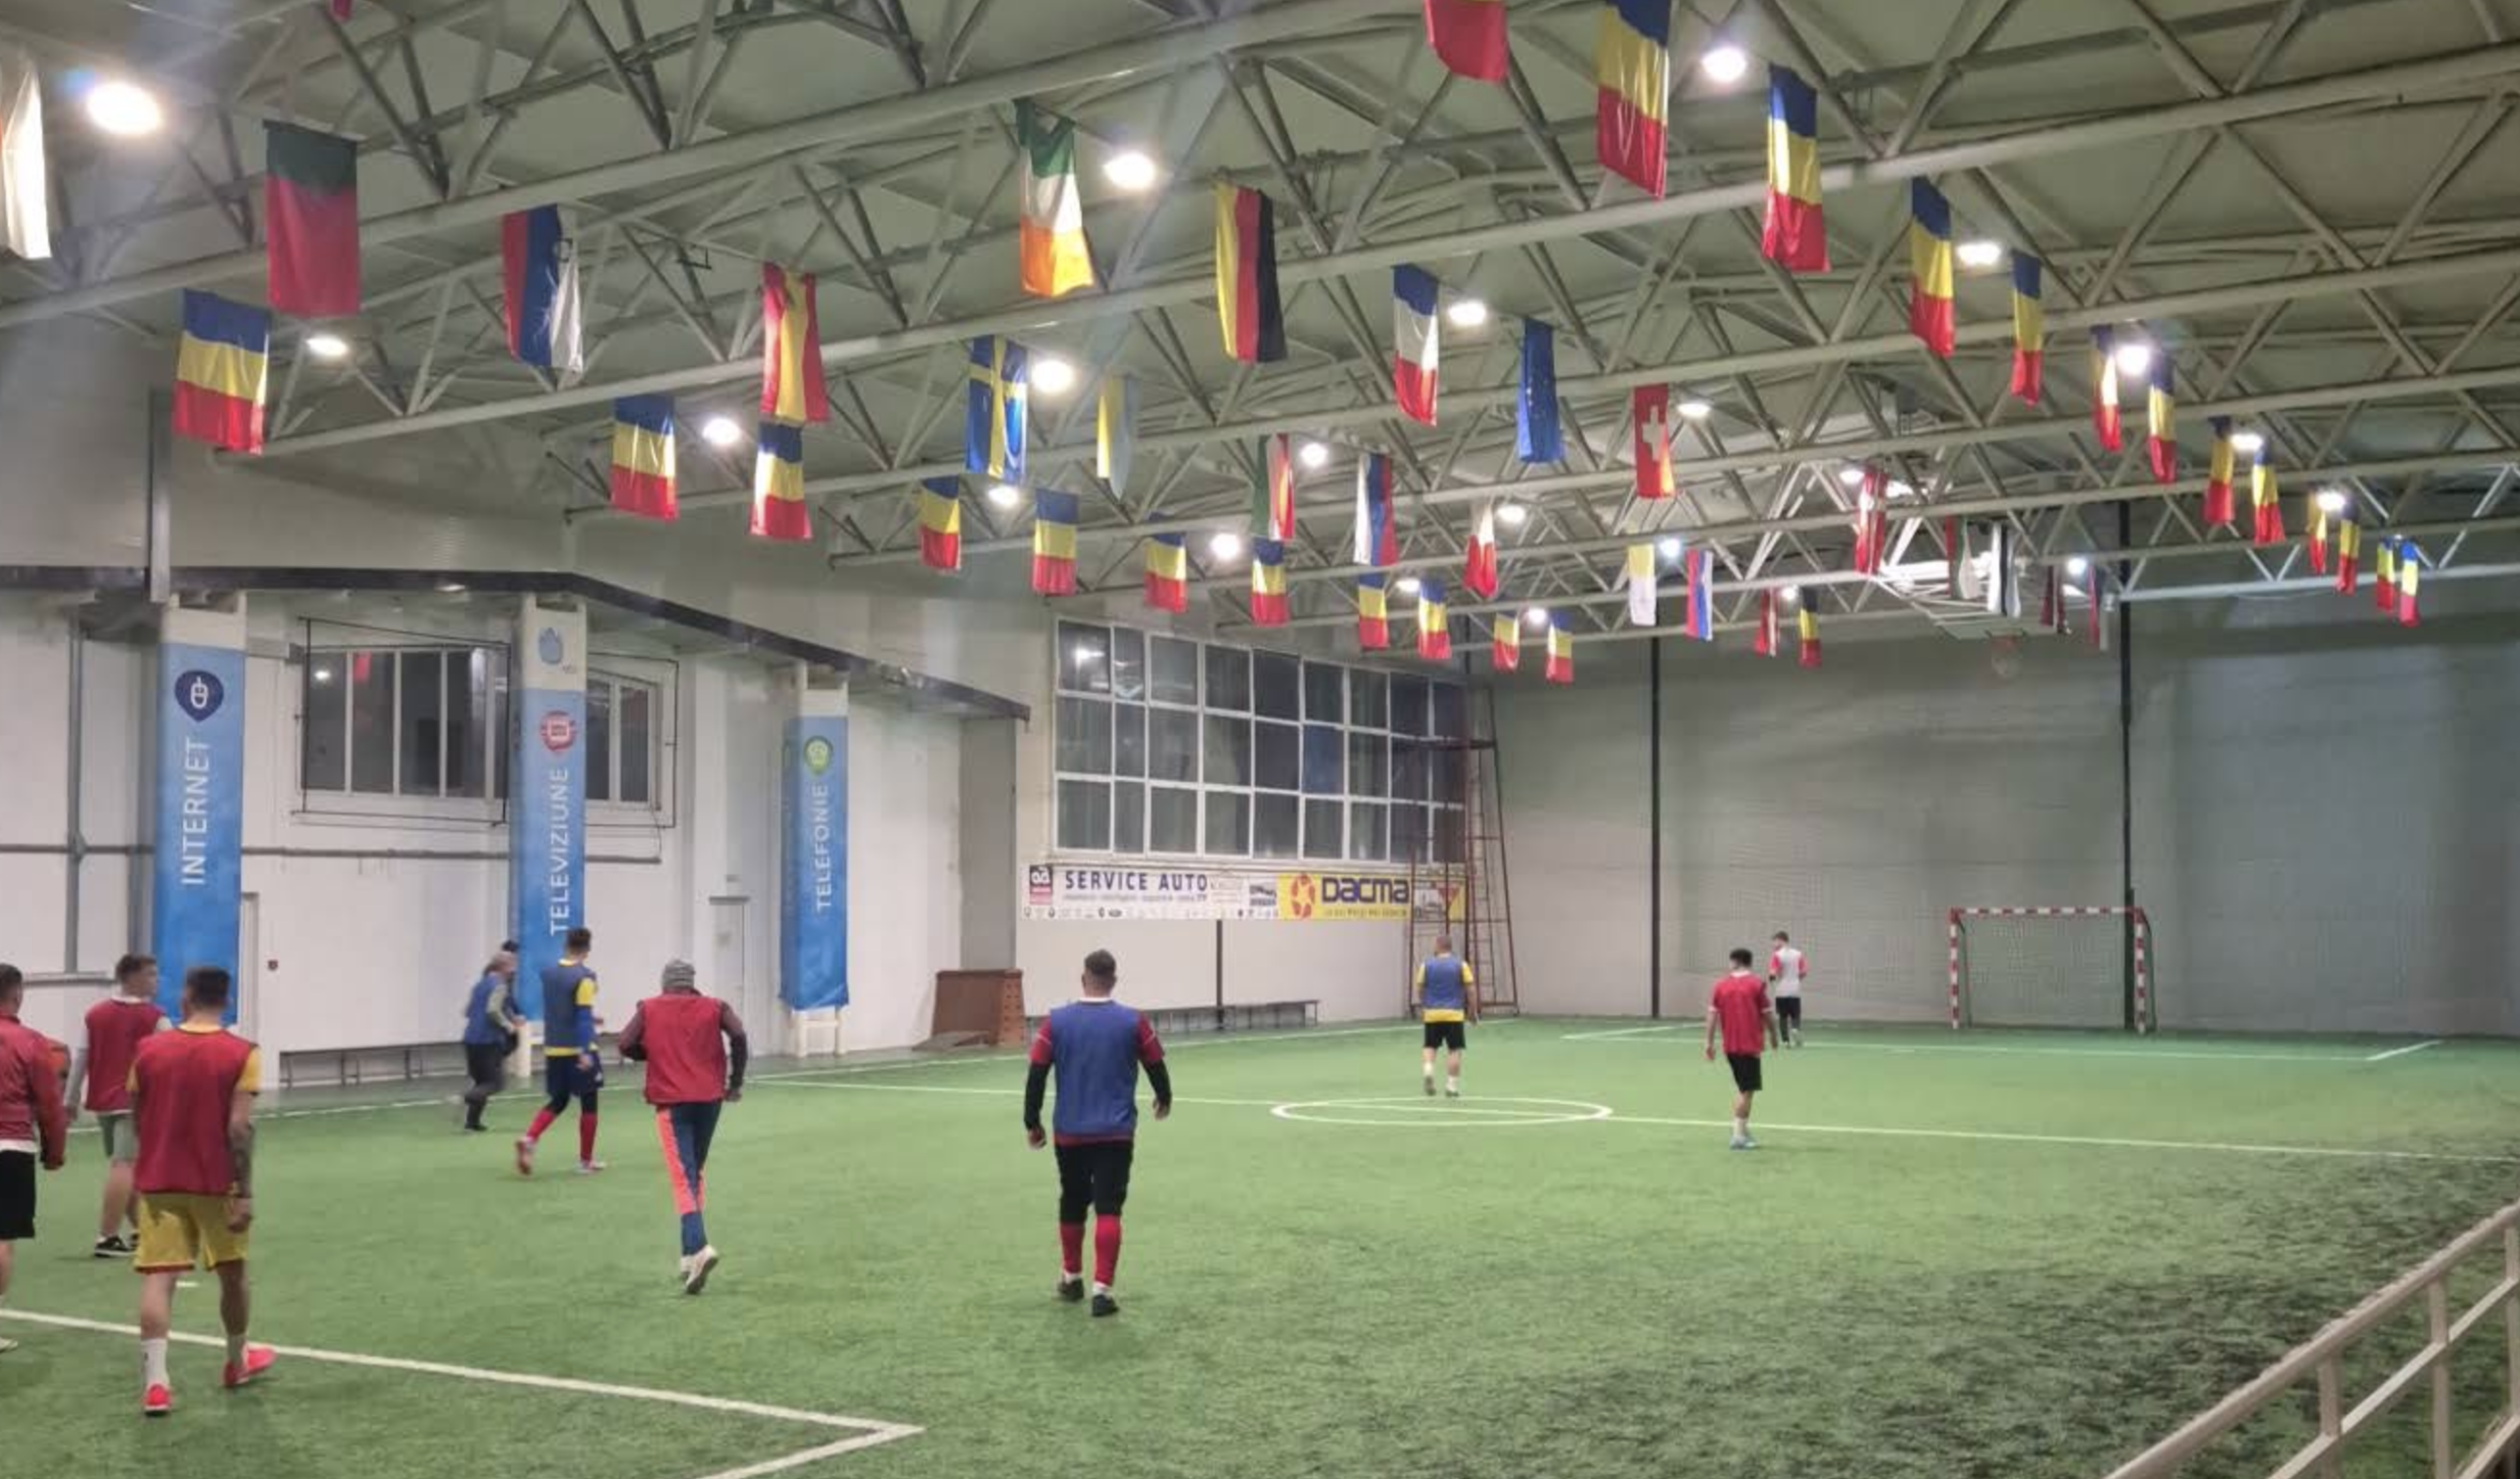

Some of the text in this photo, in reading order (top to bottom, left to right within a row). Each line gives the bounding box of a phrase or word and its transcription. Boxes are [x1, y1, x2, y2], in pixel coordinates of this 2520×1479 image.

[180, 737, 211, 885] INTERNET
[549, 766, 570, 936] TELEVIZIUNE
[812, 784, 832, 913] TELEFONIE
[1065, 870, 1149, 890] SERVICE
[1159, 873, 1208, 892] AUTO
